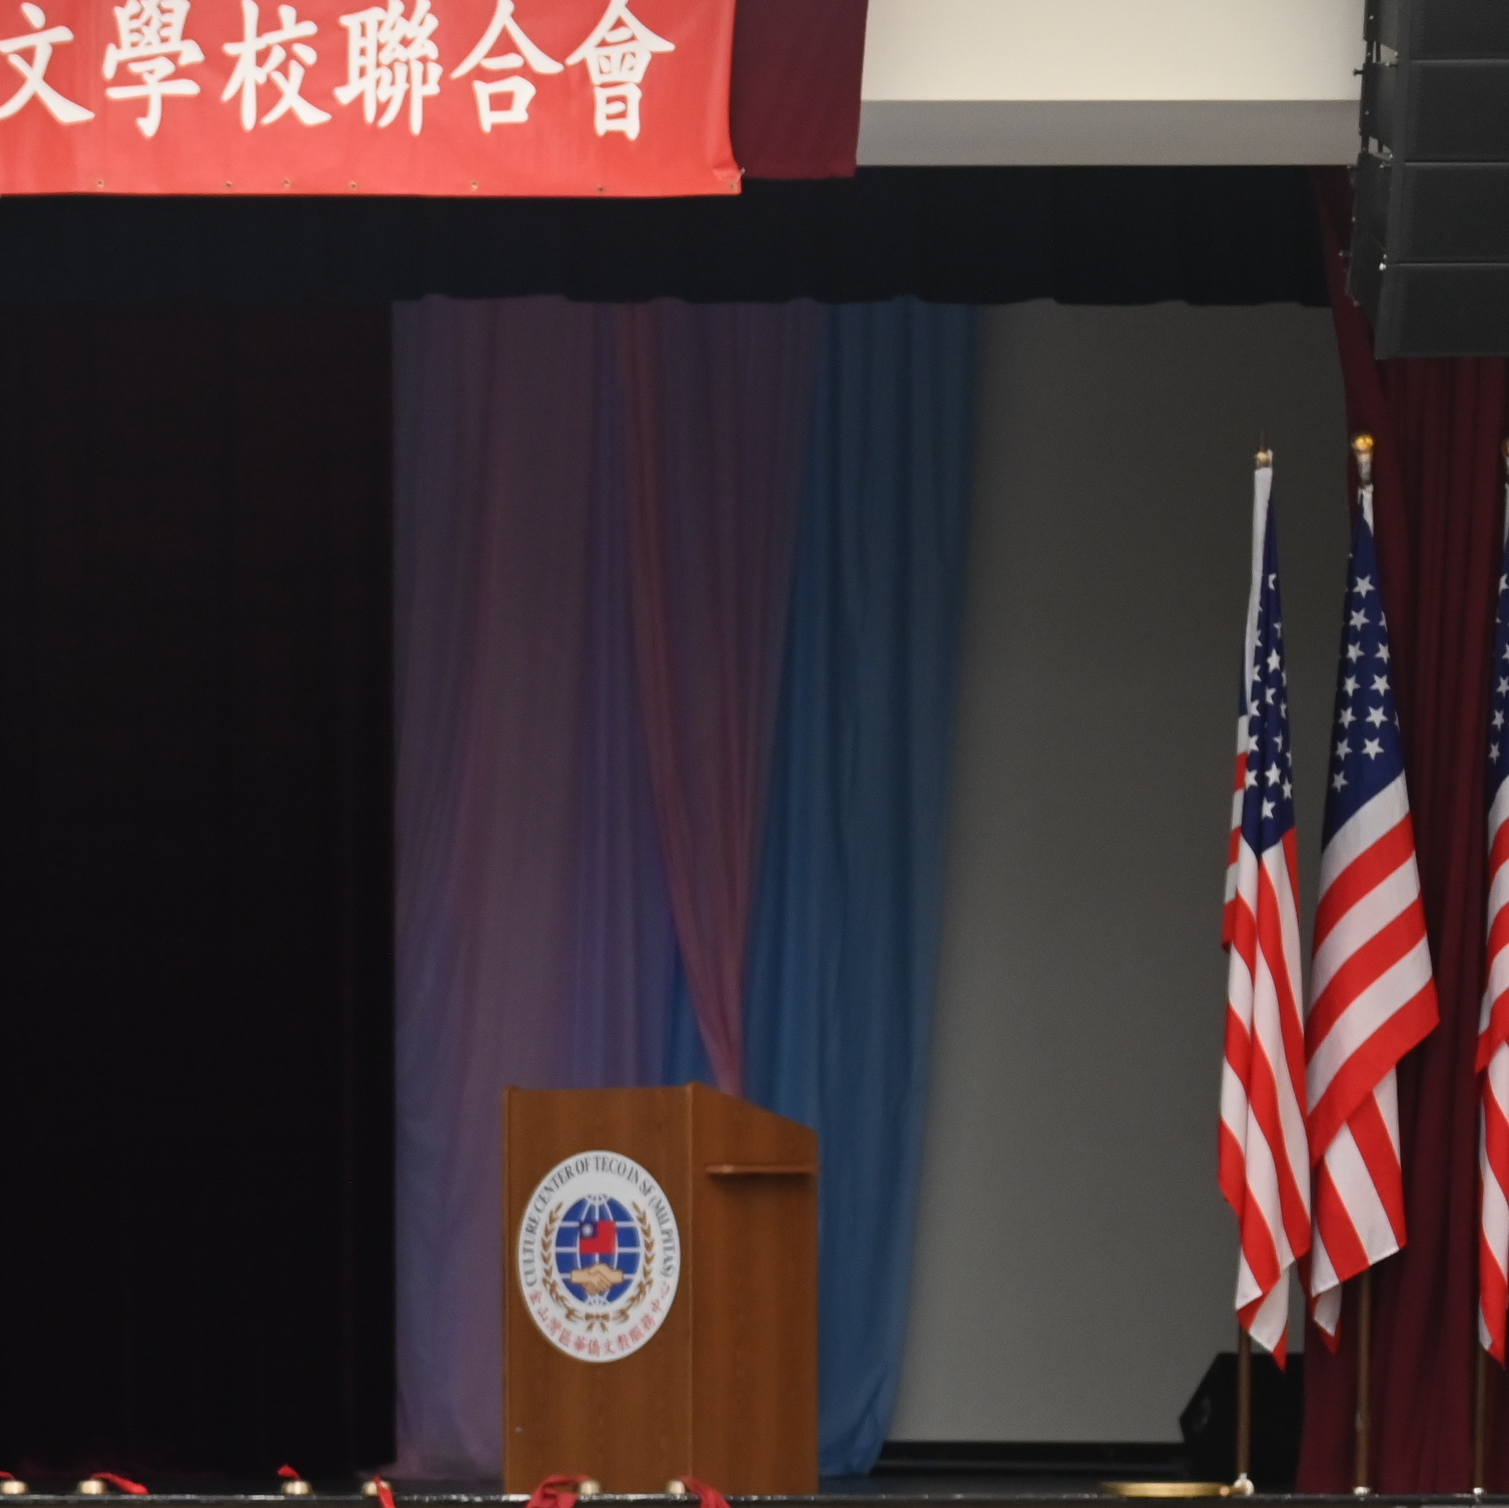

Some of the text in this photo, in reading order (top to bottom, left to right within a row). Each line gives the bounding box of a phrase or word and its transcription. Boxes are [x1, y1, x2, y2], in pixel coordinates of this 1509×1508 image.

[522, 1212, 541, 1287] CULTURE
[534, 1165, 575, 1213] CENTER
[575, 1156, 592, 1175] OF
[594, 1156, 627, 1175] TECO
[626, 1165, 640, 1185] IN
[638, 1179, 655, 1197] SF
